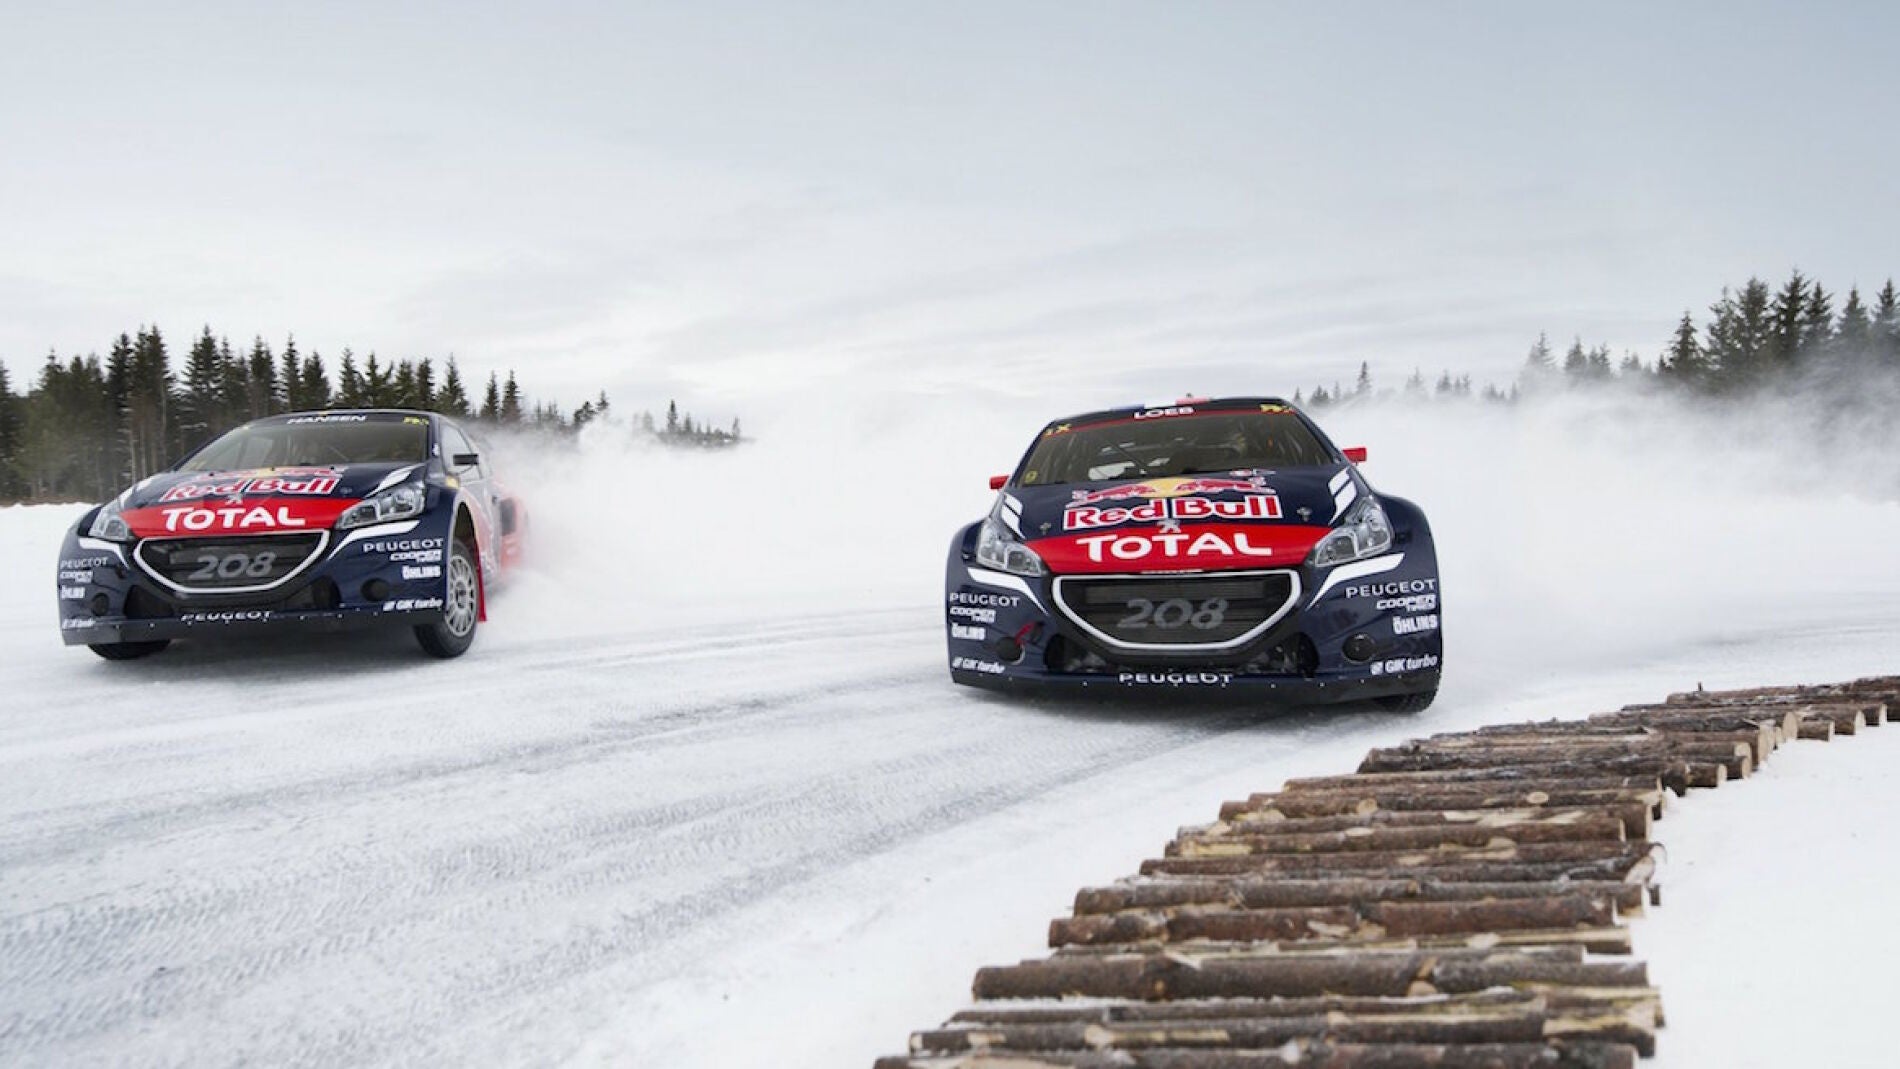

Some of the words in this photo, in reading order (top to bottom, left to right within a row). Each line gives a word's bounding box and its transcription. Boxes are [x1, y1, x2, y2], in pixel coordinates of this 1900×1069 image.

[286, 415, 367, 425] HANSEN
[1134, 406, 1194, 420] LOEB
[158, 477, 249, 503] Red
[248, 477, 341, 495] Bull
[162, 506, 306, 532] TOTAL
[1063, 498, 1167, 531] Red
[1172, 495, 1284, 519] Bull
[363, 538, 444, 553] PEUGEOT
[1076, 532, 1273, 563] TOTAL
[187, 551, 278, 580] 208
[1345, 579, 1436, 599] PEUGEOT
[949, 592, 1020, 607] PEUGEOT
[1116, 598, 1229, 630] 208
[1407, 653, 1438, 671] turbo
[1118, 672, 1233, 684] PEUGEOT
